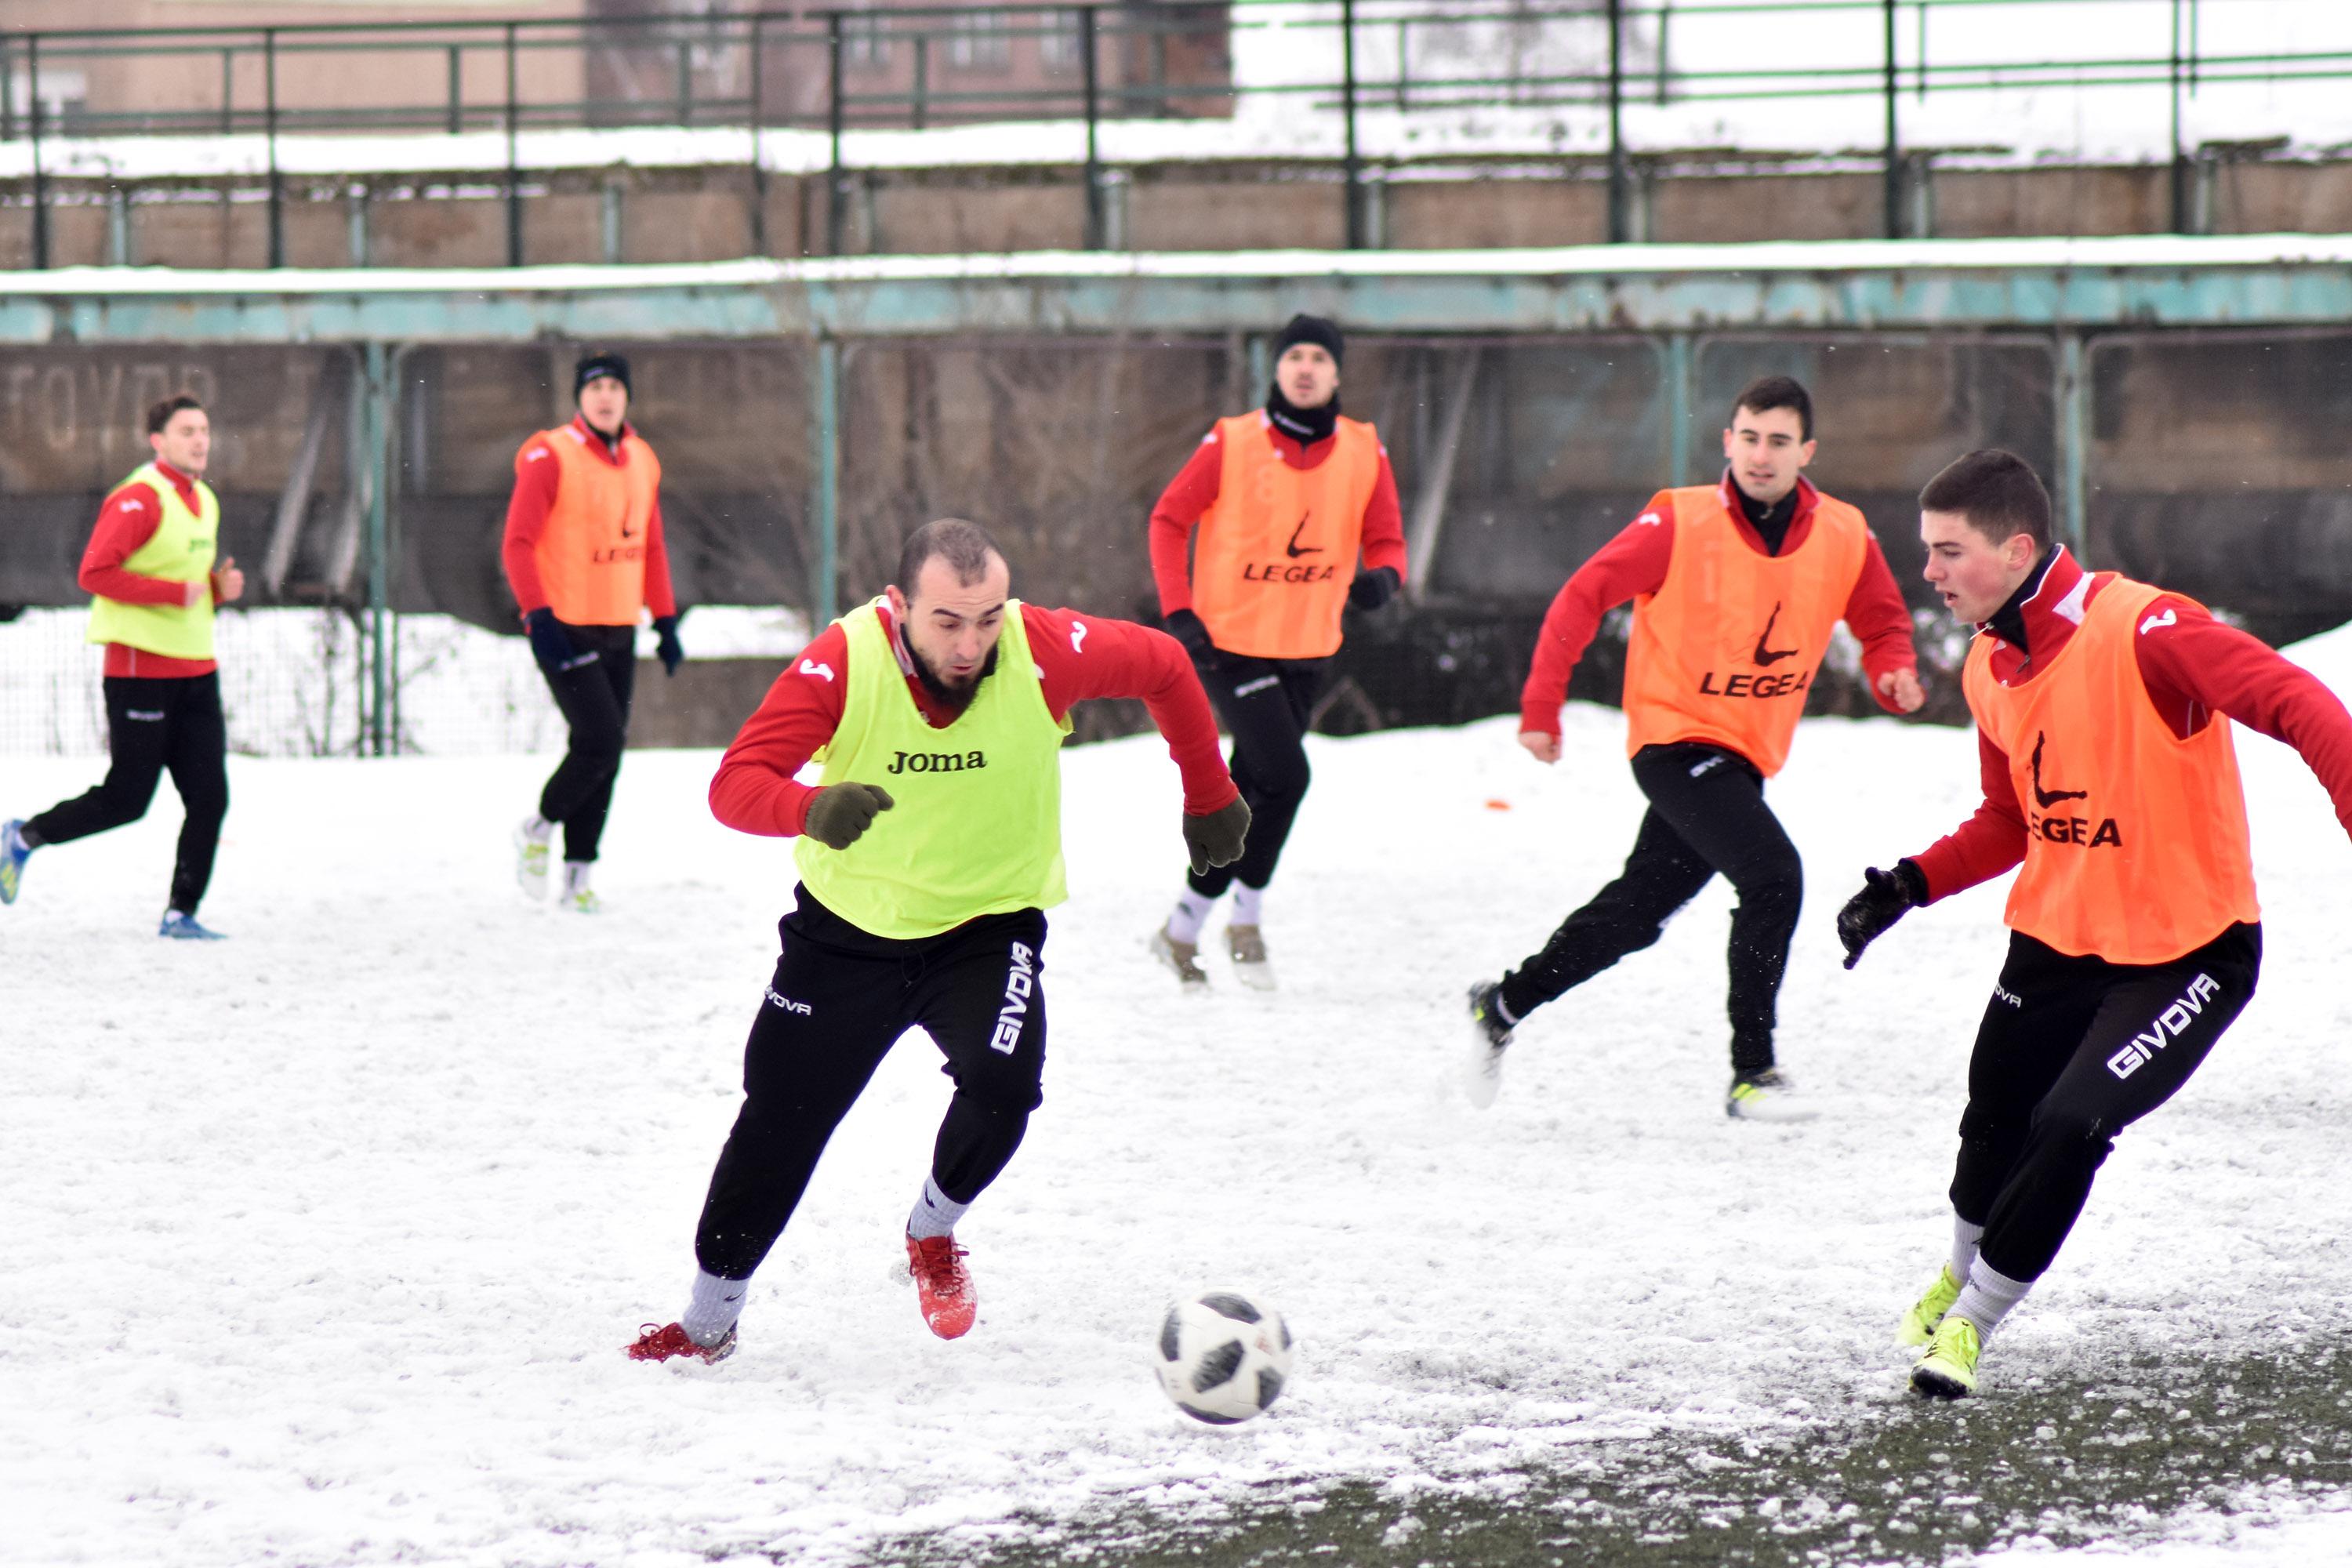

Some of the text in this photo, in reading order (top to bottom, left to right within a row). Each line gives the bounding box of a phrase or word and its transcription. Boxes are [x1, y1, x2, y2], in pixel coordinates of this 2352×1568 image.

[1243, 563, 1334, 583] LEGEA
[1699, 671, 1808, 699] LEGEA
[887, 750, 988, 775] Joma
[2027, 811, 2123, 848] EGEA
[990, 941, 1033, 1055] GIVOVA
[2107, 973, 2220, 1080] GIVOVA
